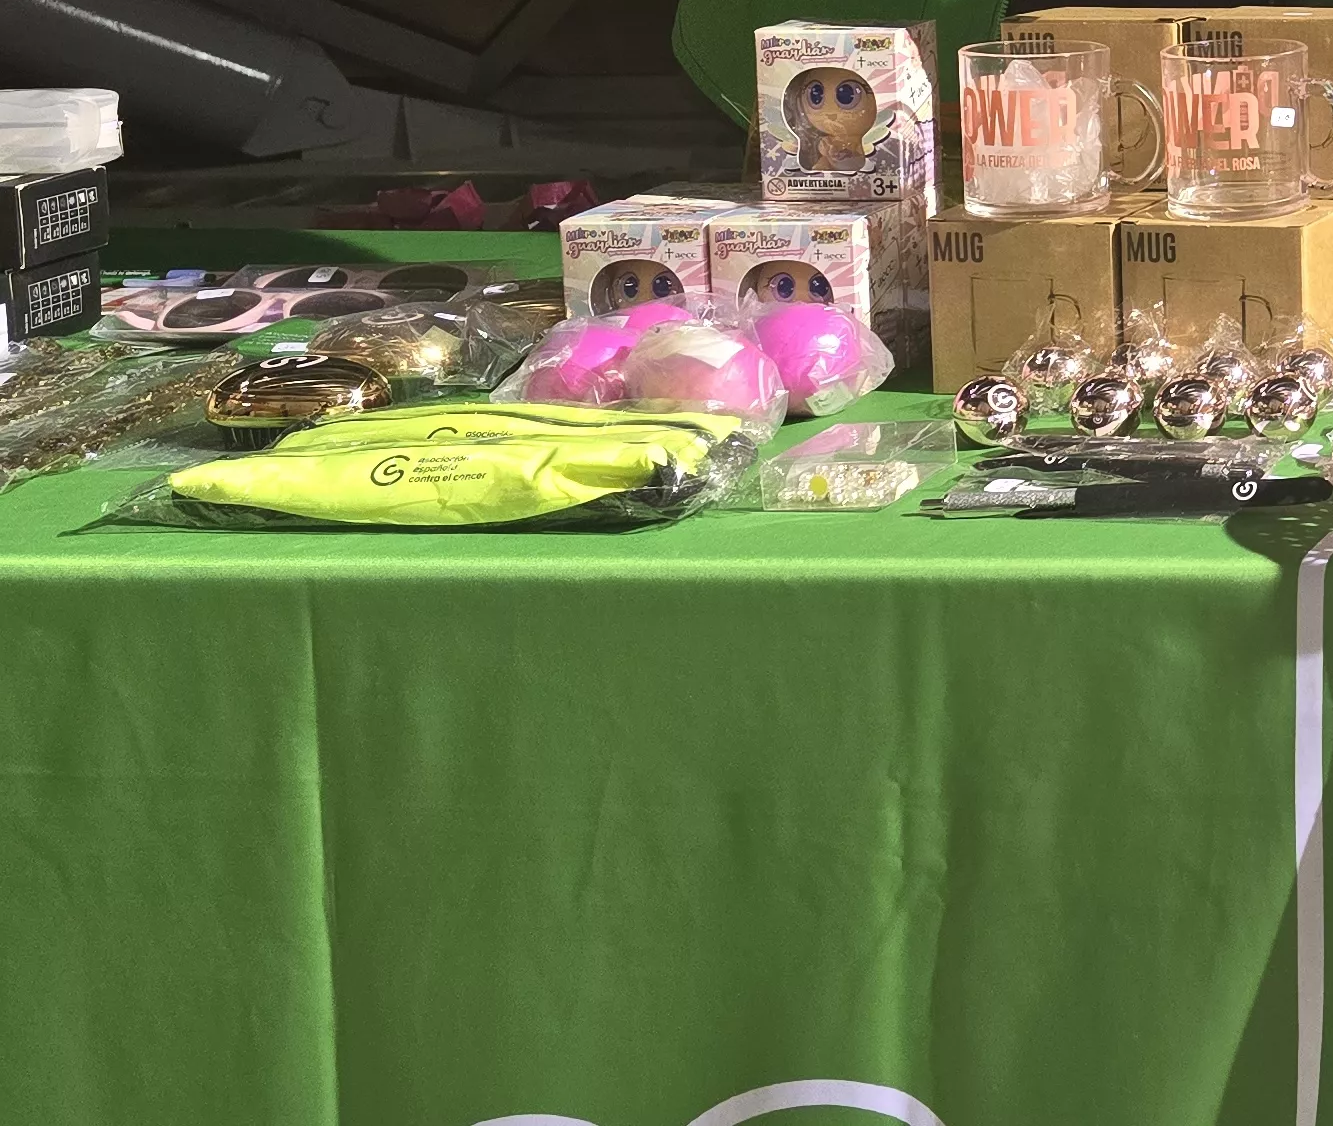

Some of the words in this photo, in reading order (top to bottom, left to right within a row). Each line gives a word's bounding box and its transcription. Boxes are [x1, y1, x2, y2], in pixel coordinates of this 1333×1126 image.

[1007, 32, 1055, 55] MUG
[1194, 31, 1243, 58] MUG
[963, 86, 1078, 148] OWER
[988, 154, 1025, 169] FUERZA
[1232, 157, 1261, 171] ROSA
[787, 178, 846, 189] ADVERTENCIA:
[933, 232, 984, 263] MUG
[1126, 232, 1177, 263] MUG
[409, 474, 441, 483] contra
[442, 473, 452, 482] el
